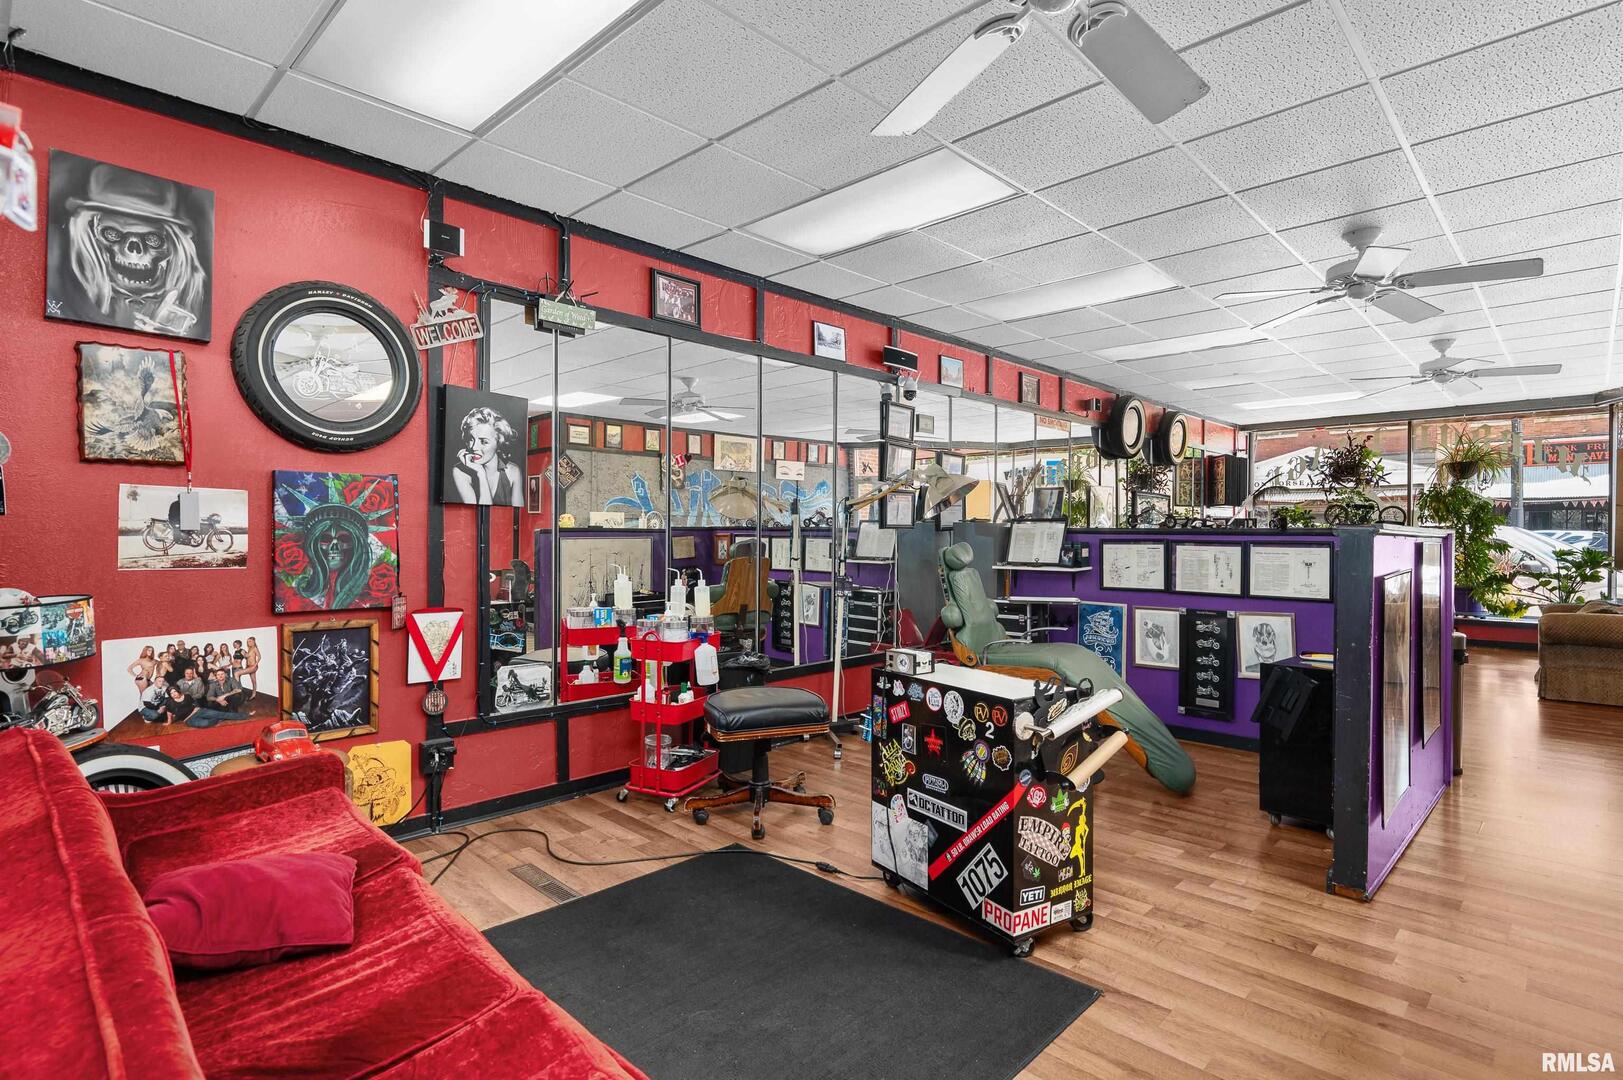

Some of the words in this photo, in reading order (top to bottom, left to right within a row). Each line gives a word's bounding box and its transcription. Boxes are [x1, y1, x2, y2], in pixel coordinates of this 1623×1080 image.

[342, 293, 373, 308] DAVIDSON
[415, 318, 480, 346] WELCOME
[1548, 453, 1575, 463] MN
[985, 721, 995, 739] 2
[963, 825, 983, 847] DRAWER
[980, 815, 994, 831] LOAD
[991, 801, 1010, 820] RATING
[1020, 838, 1059, 865] TATTOO
[961, 848, 1004, 905] 1075
[1022, 889, 1044, 902] YETI
[984, 901, 1048, 934] PROPANE
